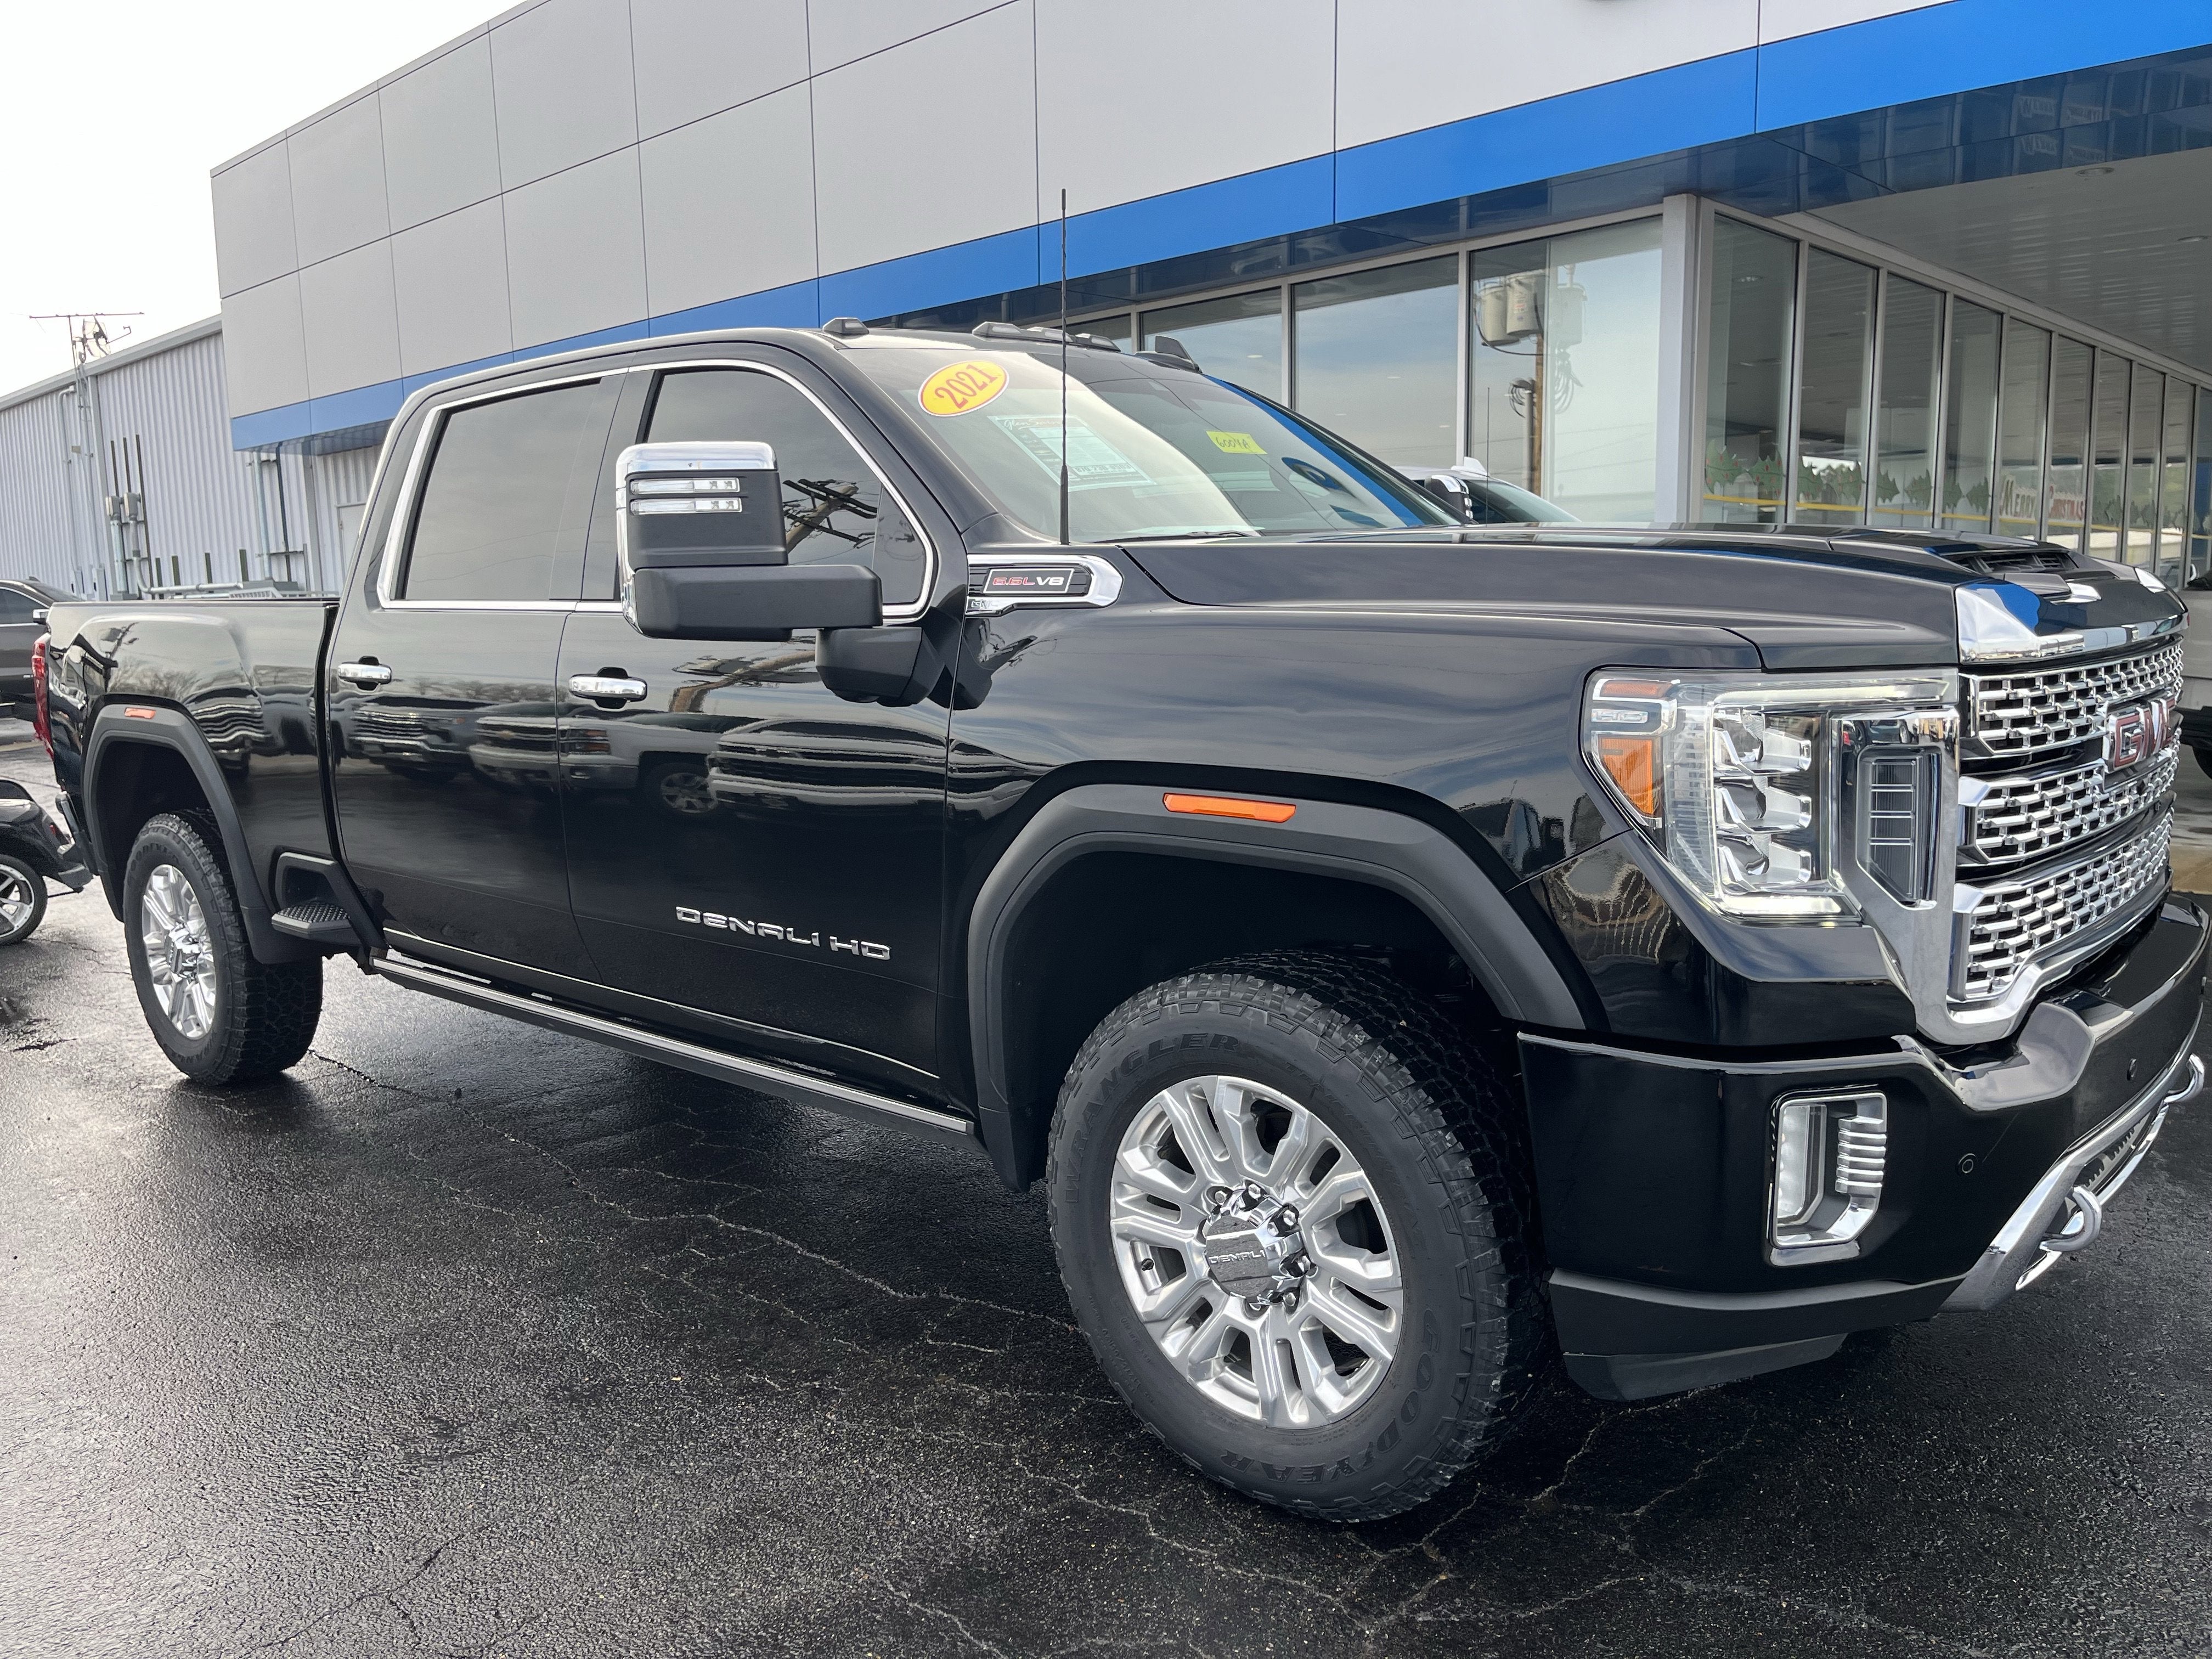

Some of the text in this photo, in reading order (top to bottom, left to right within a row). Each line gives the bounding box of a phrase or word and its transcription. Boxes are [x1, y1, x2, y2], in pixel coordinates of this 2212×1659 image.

[934, 364, 997, 409] 2021
[2109, 696, 2177, 771] GMC
[676, 906, 891, 960] DENALI HD
[1064, 1032, 1239, 1203] WRANGLER
[1209, 1249, 1266, 1264] DENALI
[1220, 1309, 1440, 1485] GOODYEAR
